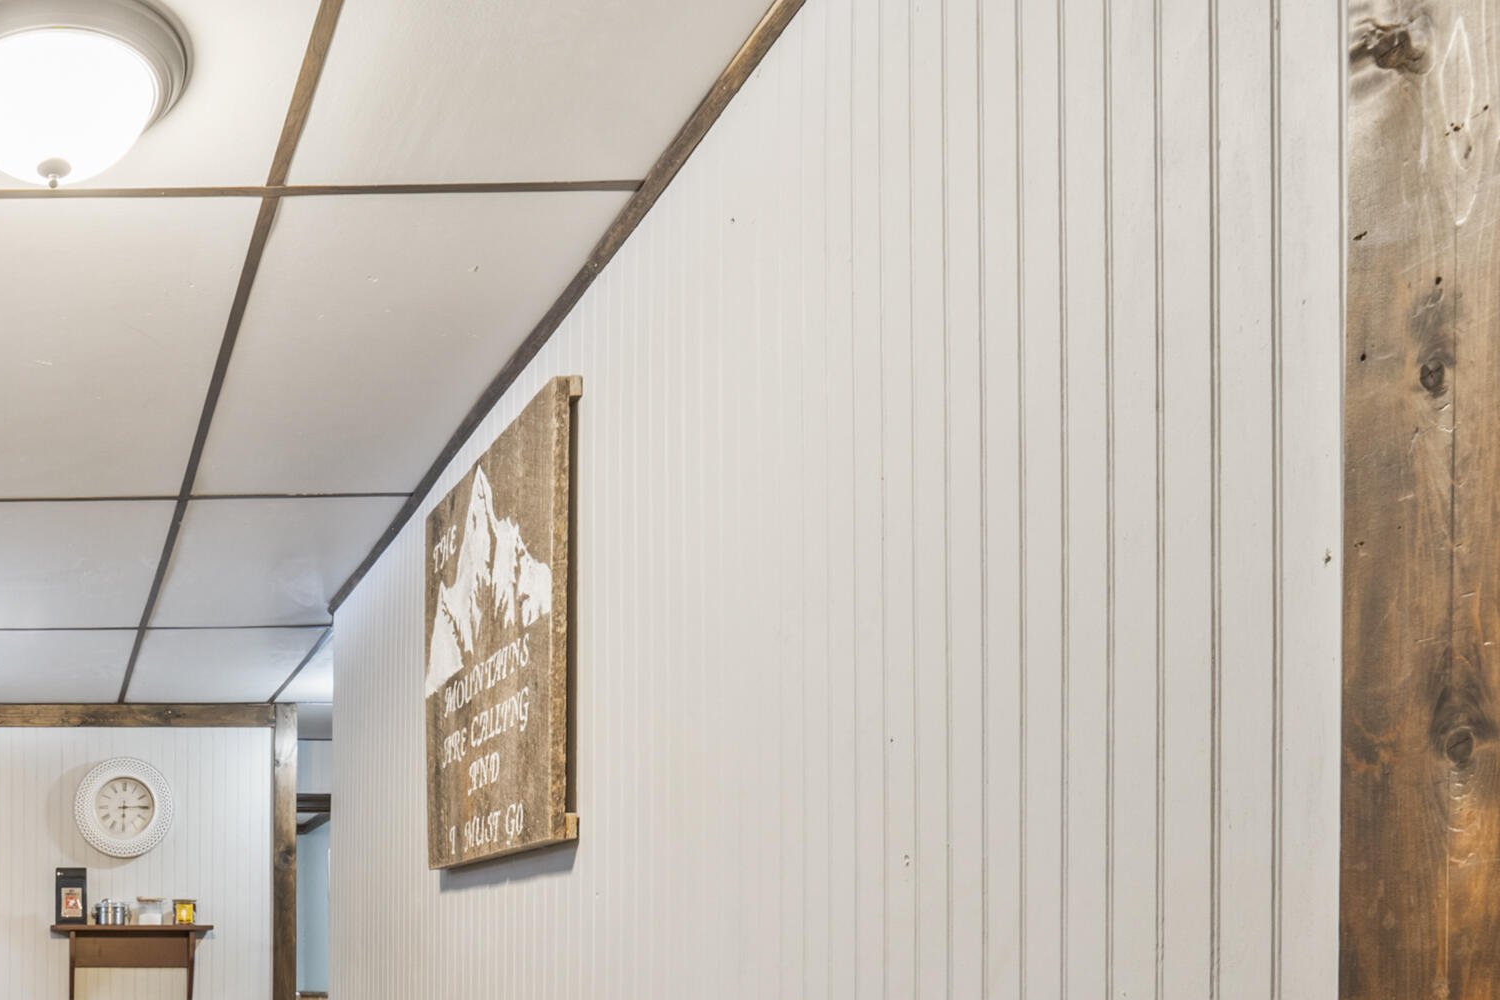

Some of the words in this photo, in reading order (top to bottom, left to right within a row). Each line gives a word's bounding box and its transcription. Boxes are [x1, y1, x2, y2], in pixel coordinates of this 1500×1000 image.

[432, 524, 457, 574] THE
[444, 633, 530, 718] MOUNTAINS
[442, 727, 467, 769] ARE
[470, 686, 530, 747] CALLING
[467, 751, 500, 796] AND
[449, 825, 457, 855] I
[464, 810, 501, 852] MUST
[505, 803, 524, 845] GO
